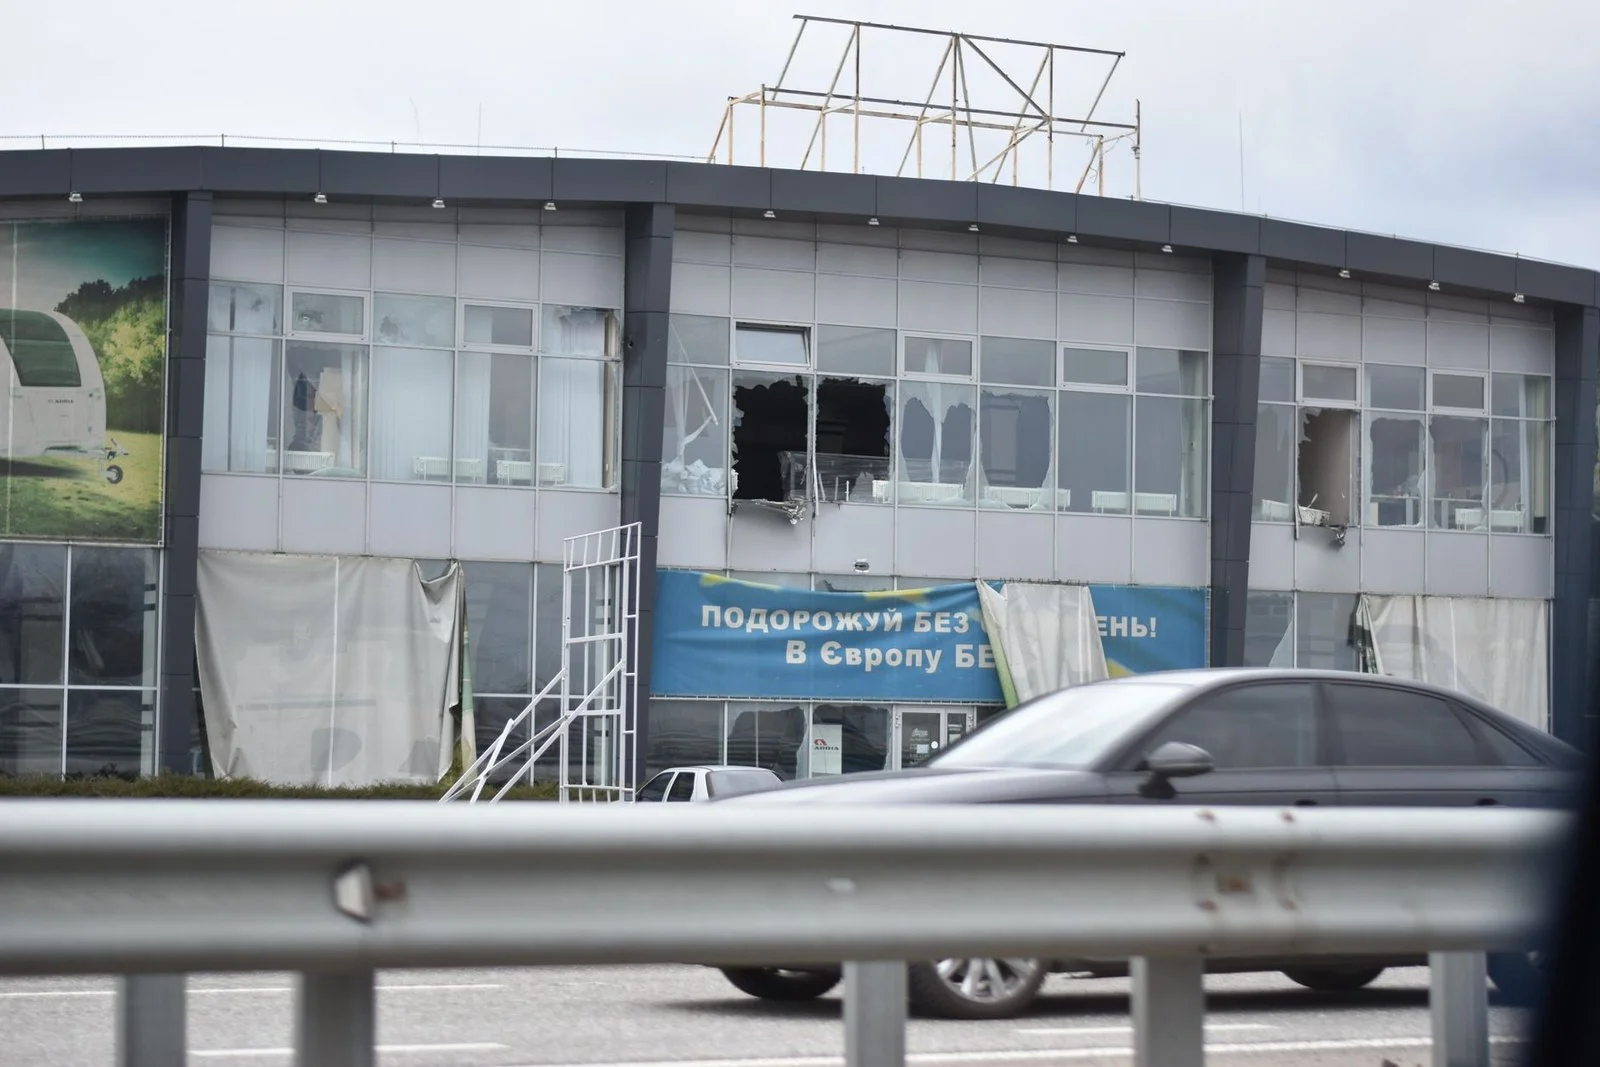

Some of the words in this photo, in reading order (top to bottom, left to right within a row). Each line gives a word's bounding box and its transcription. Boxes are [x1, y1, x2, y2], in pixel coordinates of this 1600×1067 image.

[701, 605, 903, 633] ПОДОРОЖУЙ
[914, 611, 970, 634] БЕЗ
[1096, 615, 1157, 638] ЕНЬ!
[786, 640, 807, 664] В
[820, 640, 943, 674] Європу
[955, 643, 996, 668] БЕ
